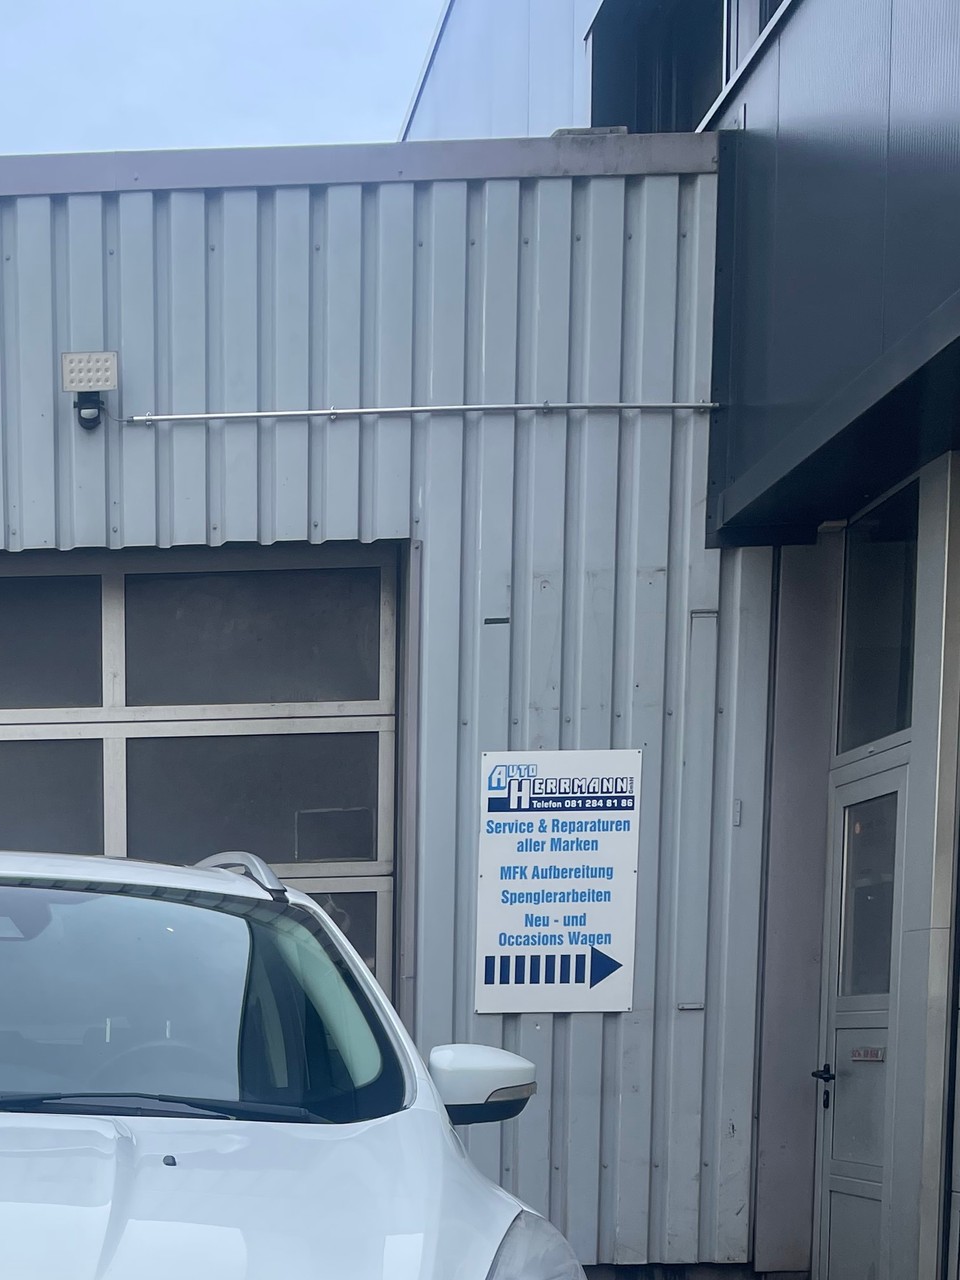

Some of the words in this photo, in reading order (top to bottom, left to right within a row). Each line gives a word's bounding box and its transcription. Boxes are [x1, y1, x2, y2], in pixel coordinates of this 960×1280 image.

[488, 764, 537, 790] AUTO
[508, 777, 628, 809] HERRMANN
[532, 800, 562, 808] Telefon
[564, 799, 582, 808] 081
[585, 799, 603, 807] 284
[606, 799, 618, 807] 81
[620, 798, 633, 807] 86
[486, 819, 534, 834] Service
[538, 818, 547, 833] &
[551, 818, 631, 834] Reparaturen
[516, 838, 546, 852] aller
[550, 837, 599, 852] Marken
[500, 866, 528, 880] MFK
[531, 865, 614, 880] Aufbereitung
[501, 888, 611, 905] Spenglerarbeiten
[524, 913, 550, 927] Neu
[563, 913, 587, 927] und
[499, 932, 564, 946] Occasions
[568, 931, 612, 946] Wagen
